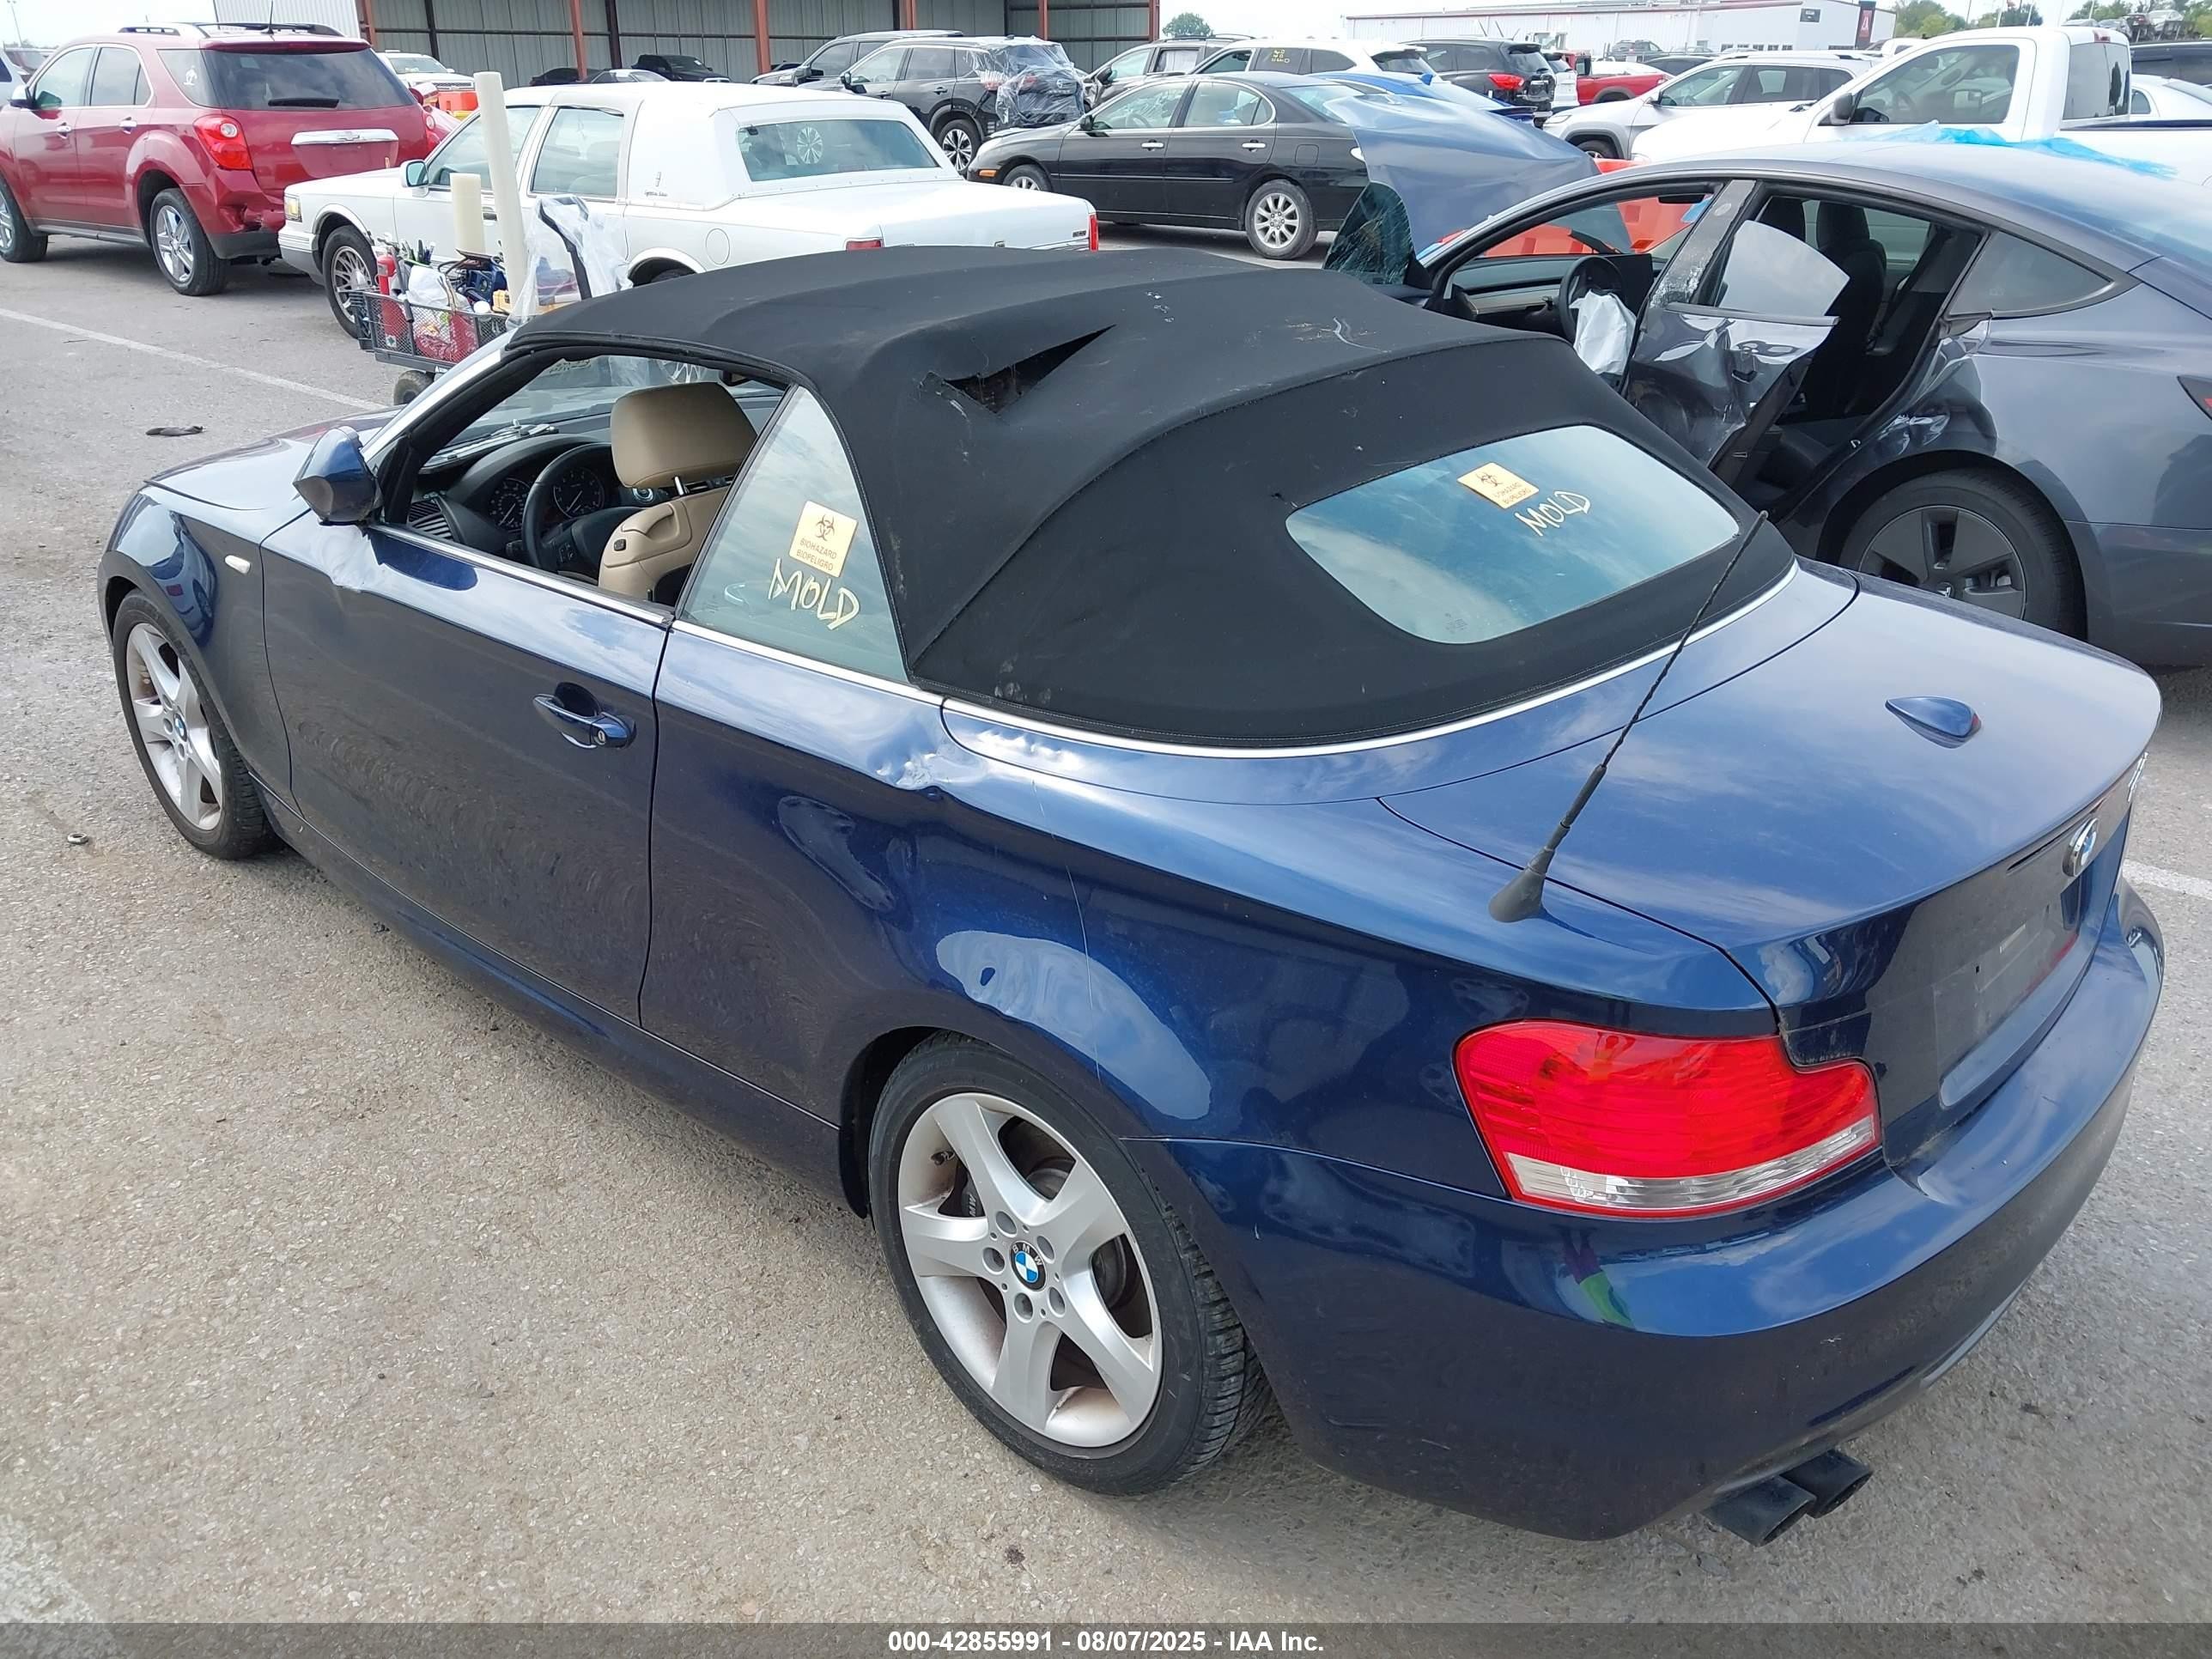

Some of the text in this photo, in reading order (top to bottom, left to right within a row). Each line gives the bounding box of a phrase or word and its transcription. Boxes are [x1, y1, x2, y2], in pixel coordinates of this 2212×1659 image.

[1514, 490, 1591, 537] MOLD
[795, 549, 834, 572] BIOPELIGRO
[799, 537, 838, 560] BIOHAZARD
[767, 557, 860, 631] MOLD
[1012, 1243, 1044, 1267] BMW
